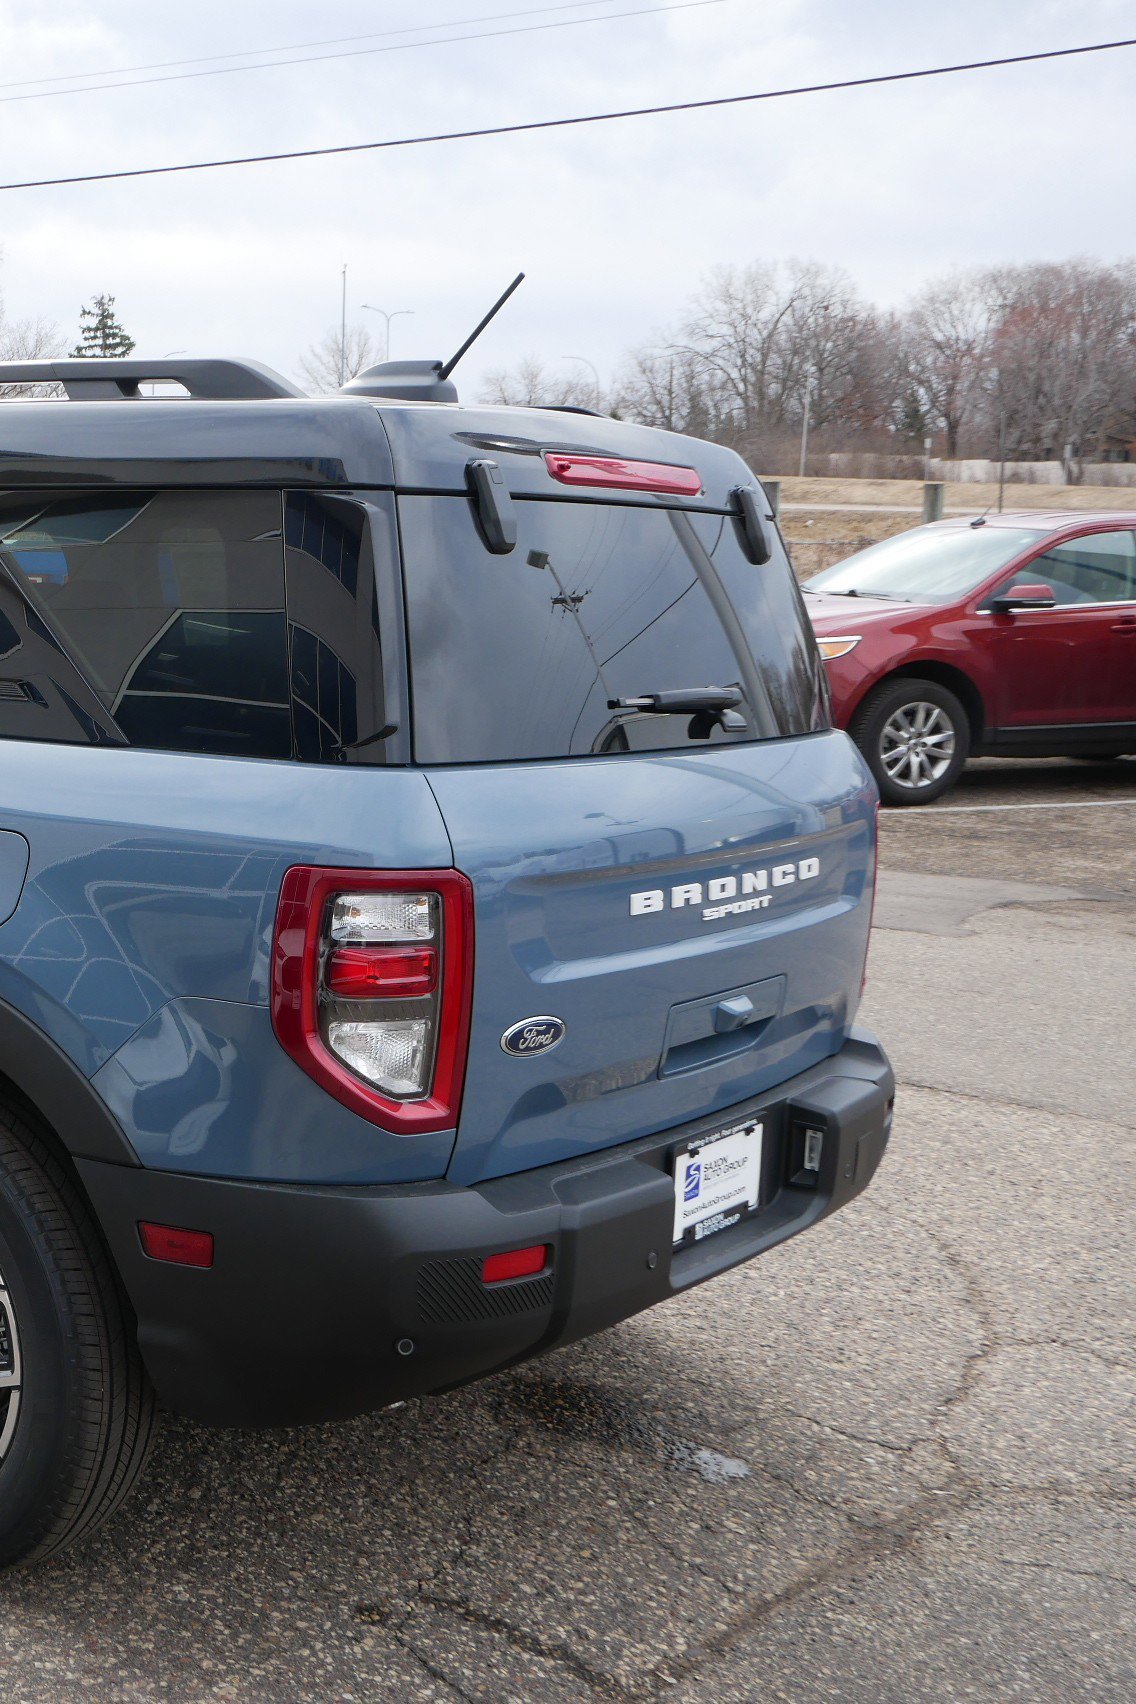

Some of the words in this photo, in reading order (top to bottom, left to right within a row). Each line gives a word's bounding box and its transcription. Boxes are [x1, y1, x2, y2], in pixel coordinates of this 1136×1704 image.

[629, 857, 820, 916] BRONCO
[702, 895, 773, 921] SPORT
[519, 1025, 555, 1049] Ford
[703, 1155, 729, 1172] SAXON
[703, 1167, 722, 1181] AUTO
[723, 1156, 748, 1174] GROUP
